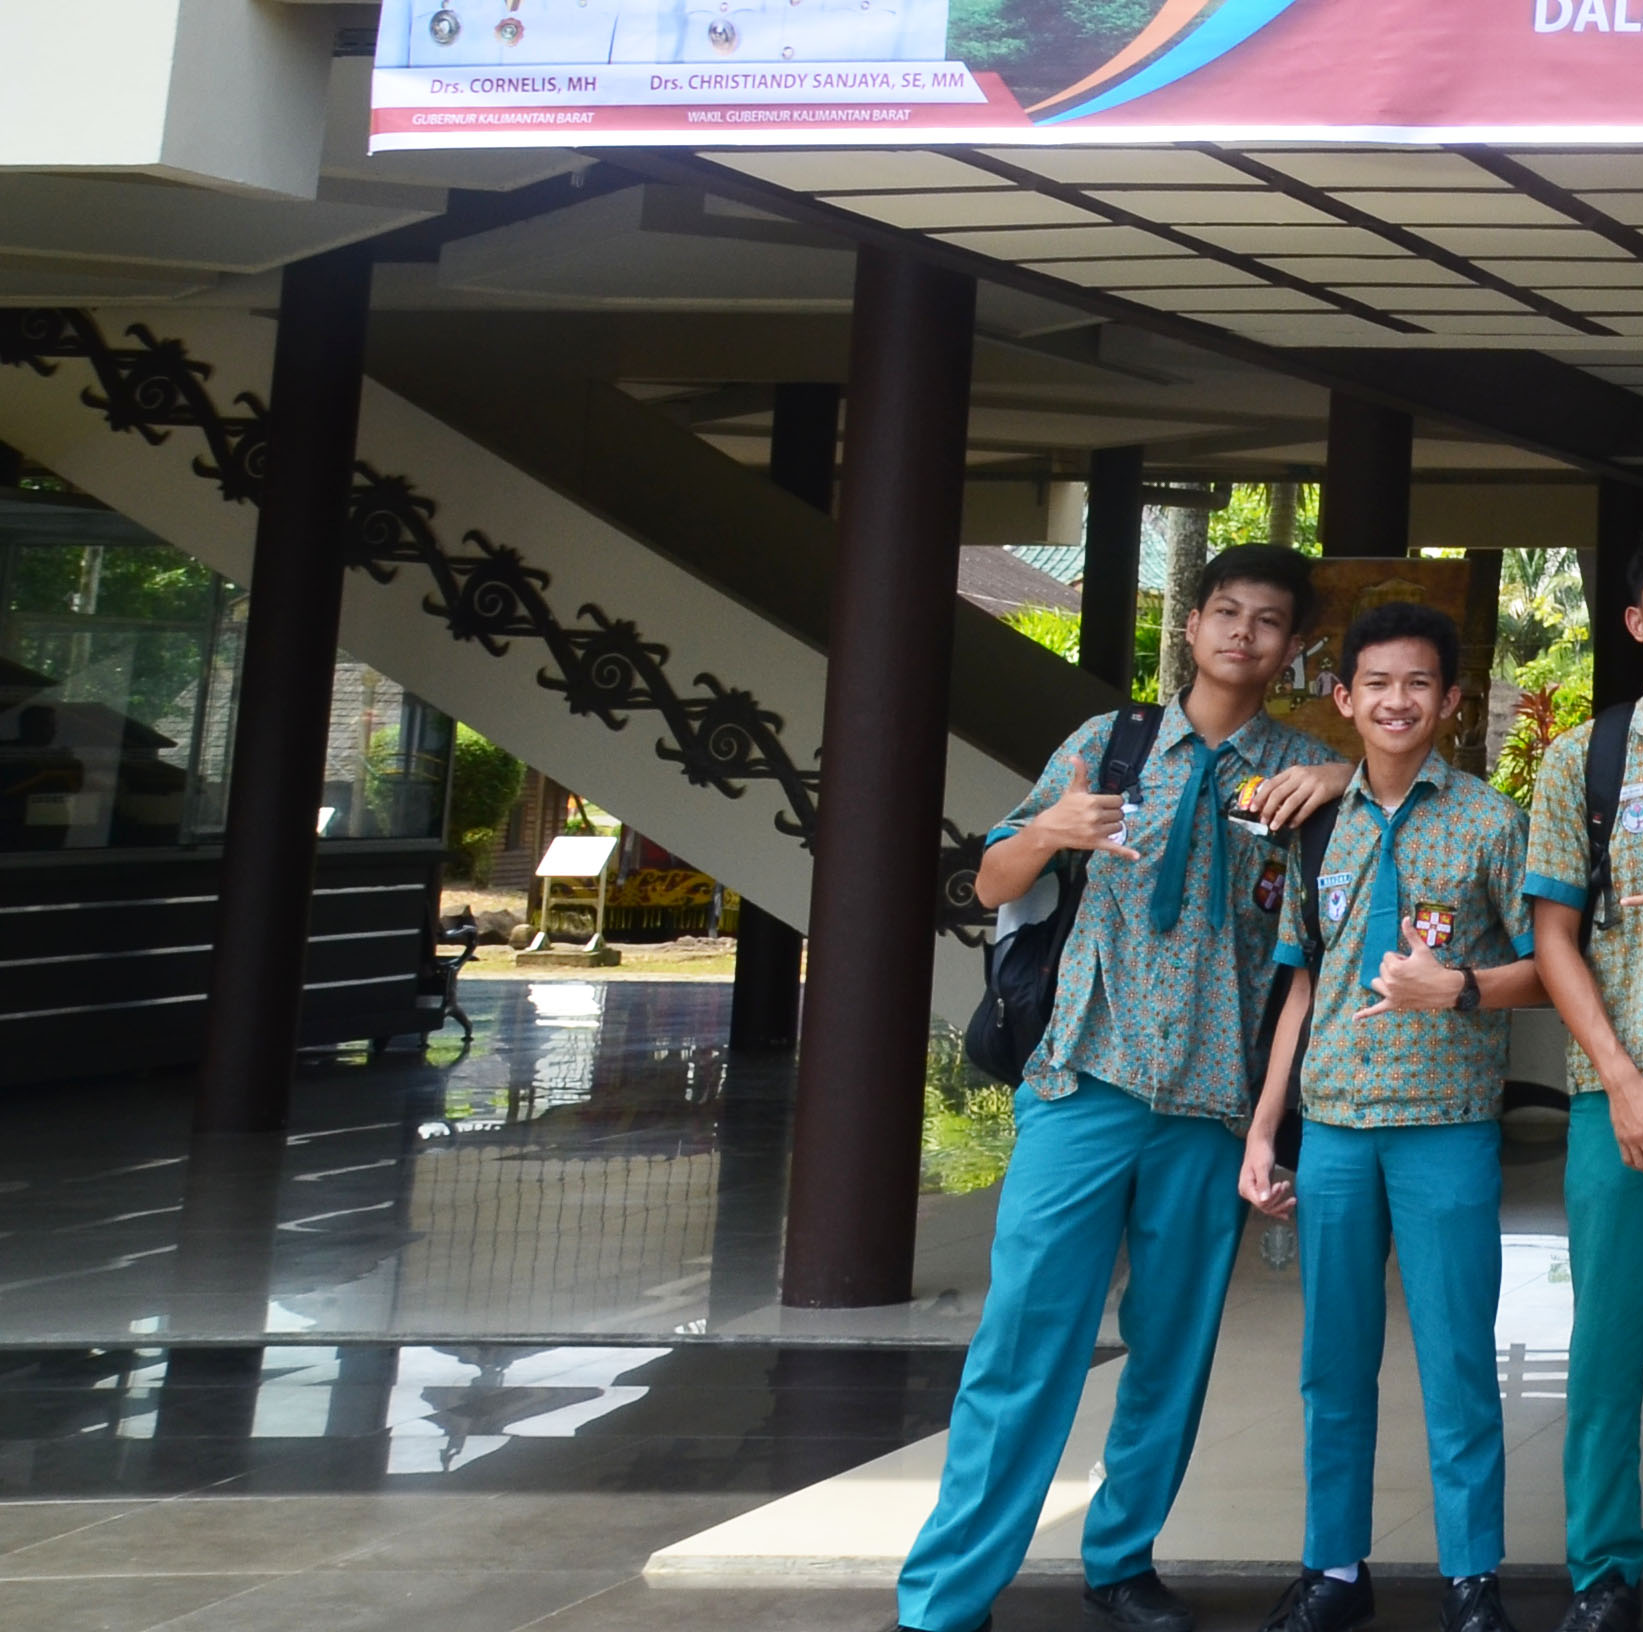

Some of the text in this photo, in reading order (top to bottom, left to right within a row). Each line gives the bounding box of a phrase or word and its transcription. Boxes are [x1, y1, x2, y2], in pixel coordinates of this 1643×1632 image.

[430, 76, 597, 94] Drs. CORNELIS, MH
[649, 71, 965, 90] Drs. CHRISTIANDY SANJAYA, SE, MM
[412, 112, 595, 125] GUBERNUR KALIMANTAN BARAT
[687, 109, 912, 123] WAKIL GUBERNUR KALIMANTAN BARAT
